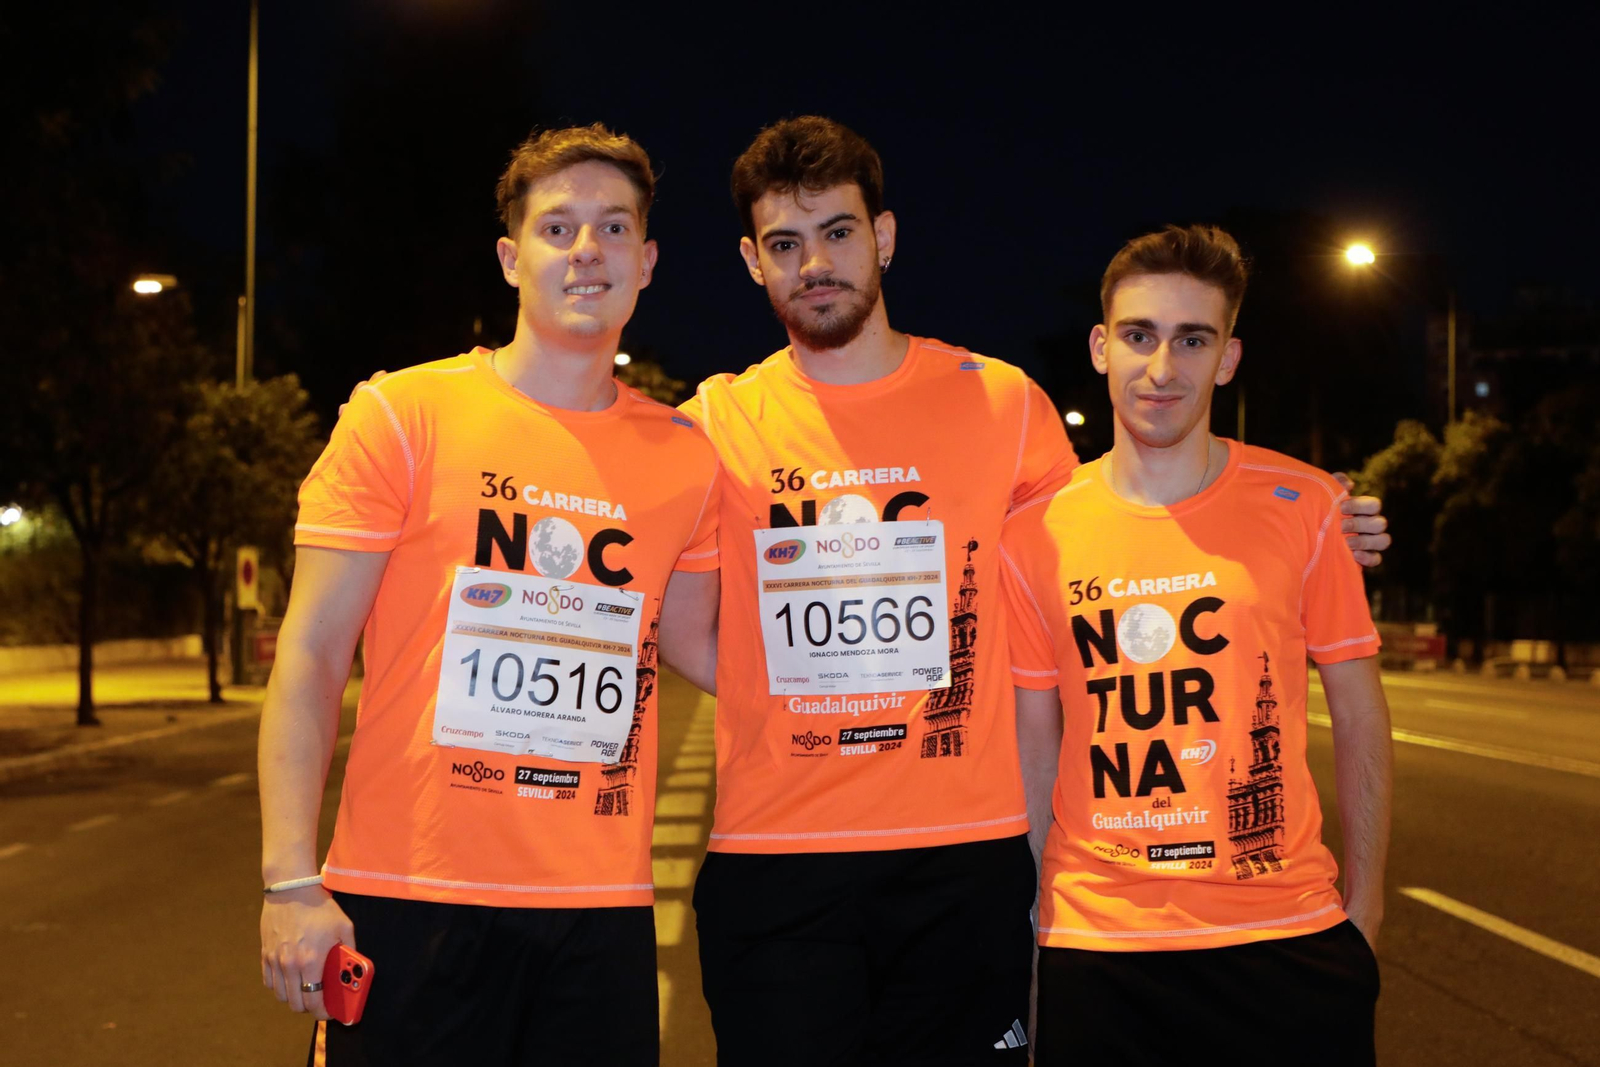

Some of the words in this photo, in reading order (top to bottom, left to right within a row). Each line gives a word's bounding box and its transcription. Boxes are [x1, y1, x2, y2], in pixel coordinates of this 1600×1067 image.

[771, 467, 805, 494] 36
[810, 466, 921, 490] CARRERA
[481, 471, 517, 501] 36
[523, 484, 627, 521] CARRERA
[1068, 576, 1103, 606] 36
[1108, 571, 1217, 598] CARRERA
[775, 595, 935, 647] 10566
[455, 624, 476, 632] XXXVI
[478, 627, 507, 636] CARRERA
[510, 631, 545, 641] NOCTURNA
[559, 638, 602, 649] GUADALQUIVIR
[776, 675, 810, 684] Cruzcampo
[912, 667, 943, 676] POWER
[926, 674, 943, 682] ADE
[460, 649, 623, 714] 10516
[788, 693, 906, 716] Guadalquivir
[1086, 667, 1220, 733] TUR
[490, 704, 522, 715] ÁLVARO
[523, 710, 555, 719] MORERA
[557, 713, 586, 723] ARANDA
[441, 725, 484, 739] Cruzcampo
[841, 731, 852, 741] 27
[853, 728, 904, 742] septiembre
[590, 740, 619, 750] POWER
[601, 749, 616, 757] ADE
[840, 744, 877, 756] SEVILLA
[878, 742, 902, 752] 2024
[1090, 739, 1187, 798] NA
[518, 769, 529, 781] 27
[532, 771, 578, 786] septiembre
[517, 786, 554, 799] SEVILLA
[555, 789, 576, 800] 2024
[1152, 796, 1171, 808] del
[1092, 807, 1211, 832] Guadalquivir
[1150, 847, 1162, 857] 27
[1164, 844, 1213, 859] septiembre
[1150, 861, 1186, 870] SEVILLA
[1188, 860, 1213, 870] 2024
